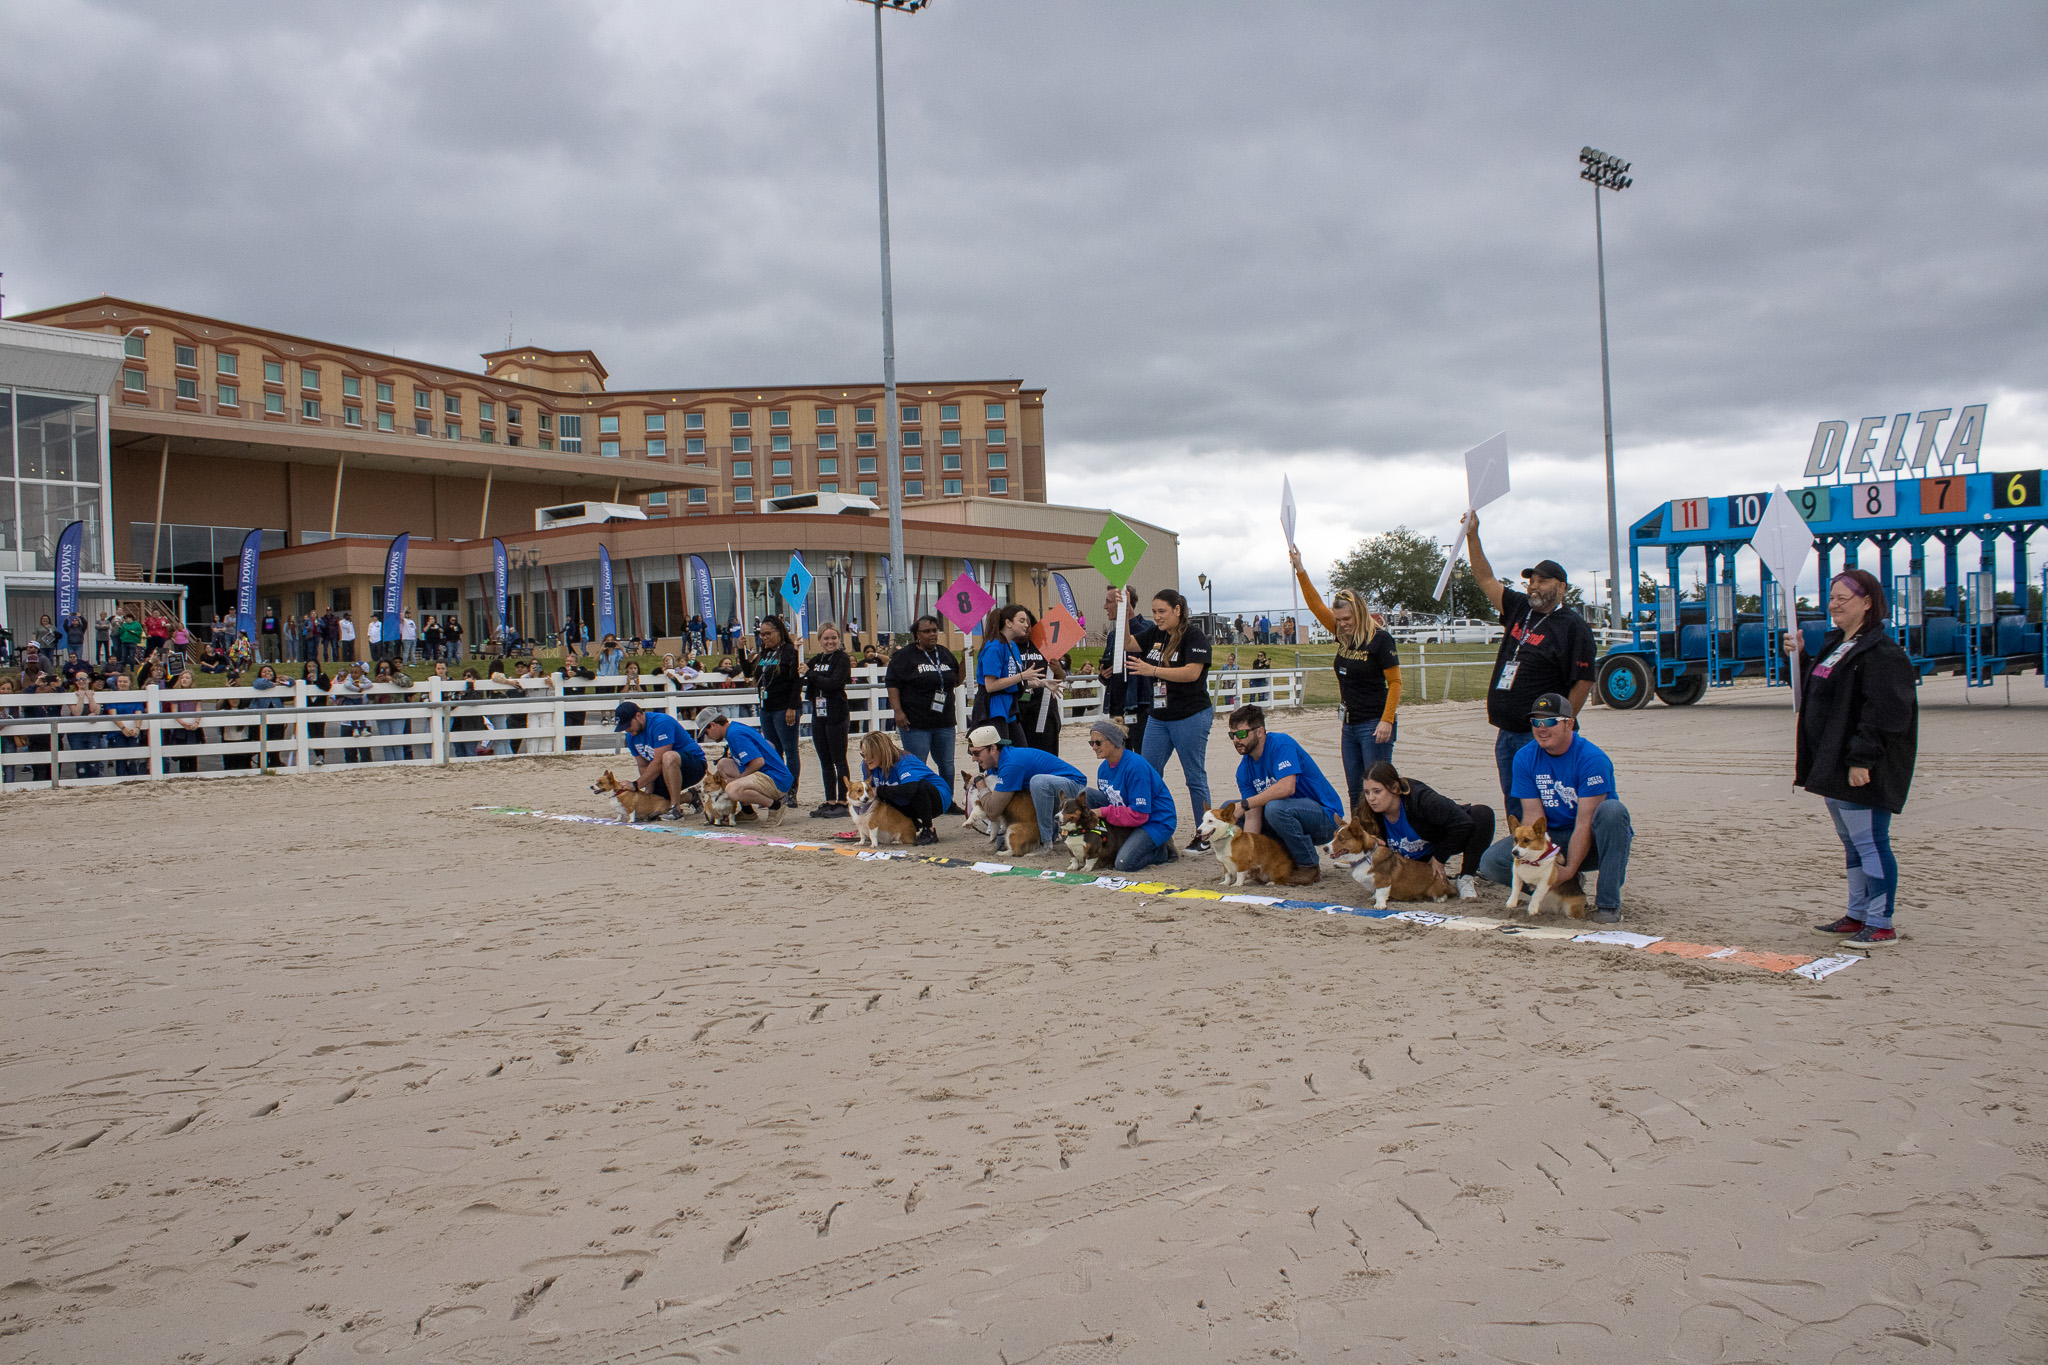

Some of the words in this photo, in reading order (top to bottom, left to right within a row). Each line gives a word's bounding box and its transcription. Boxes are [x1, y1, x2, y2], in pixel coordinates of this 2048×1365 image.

[1804, 404, 1987, 477] DELTA
[1681, 500, 1698, 529] 11
[1735, 495, 1760, 526] 10
[1802, 491, 1817, 520] 9
[1866, 486, 1882, 515] 8
[1935, 480, 1952, 510] 7
[2007, 473, 2027, 506] 6
[61, 544, 73, 582] DOWNS
[242, 548, 253, 583] DOWNS
[1106, 535, 1125, 566] 5
[389, 551, 401, 584] DOWNS
[240, 585, 250, 614] DELTA
[387, 586, 397, 613] DELTA
[791, 573, 800, 595] 9
[60, 584, 71, 616] DELTA
[956, 591, 973, 614] 8
[1049, 620, 1061, 644] 7
